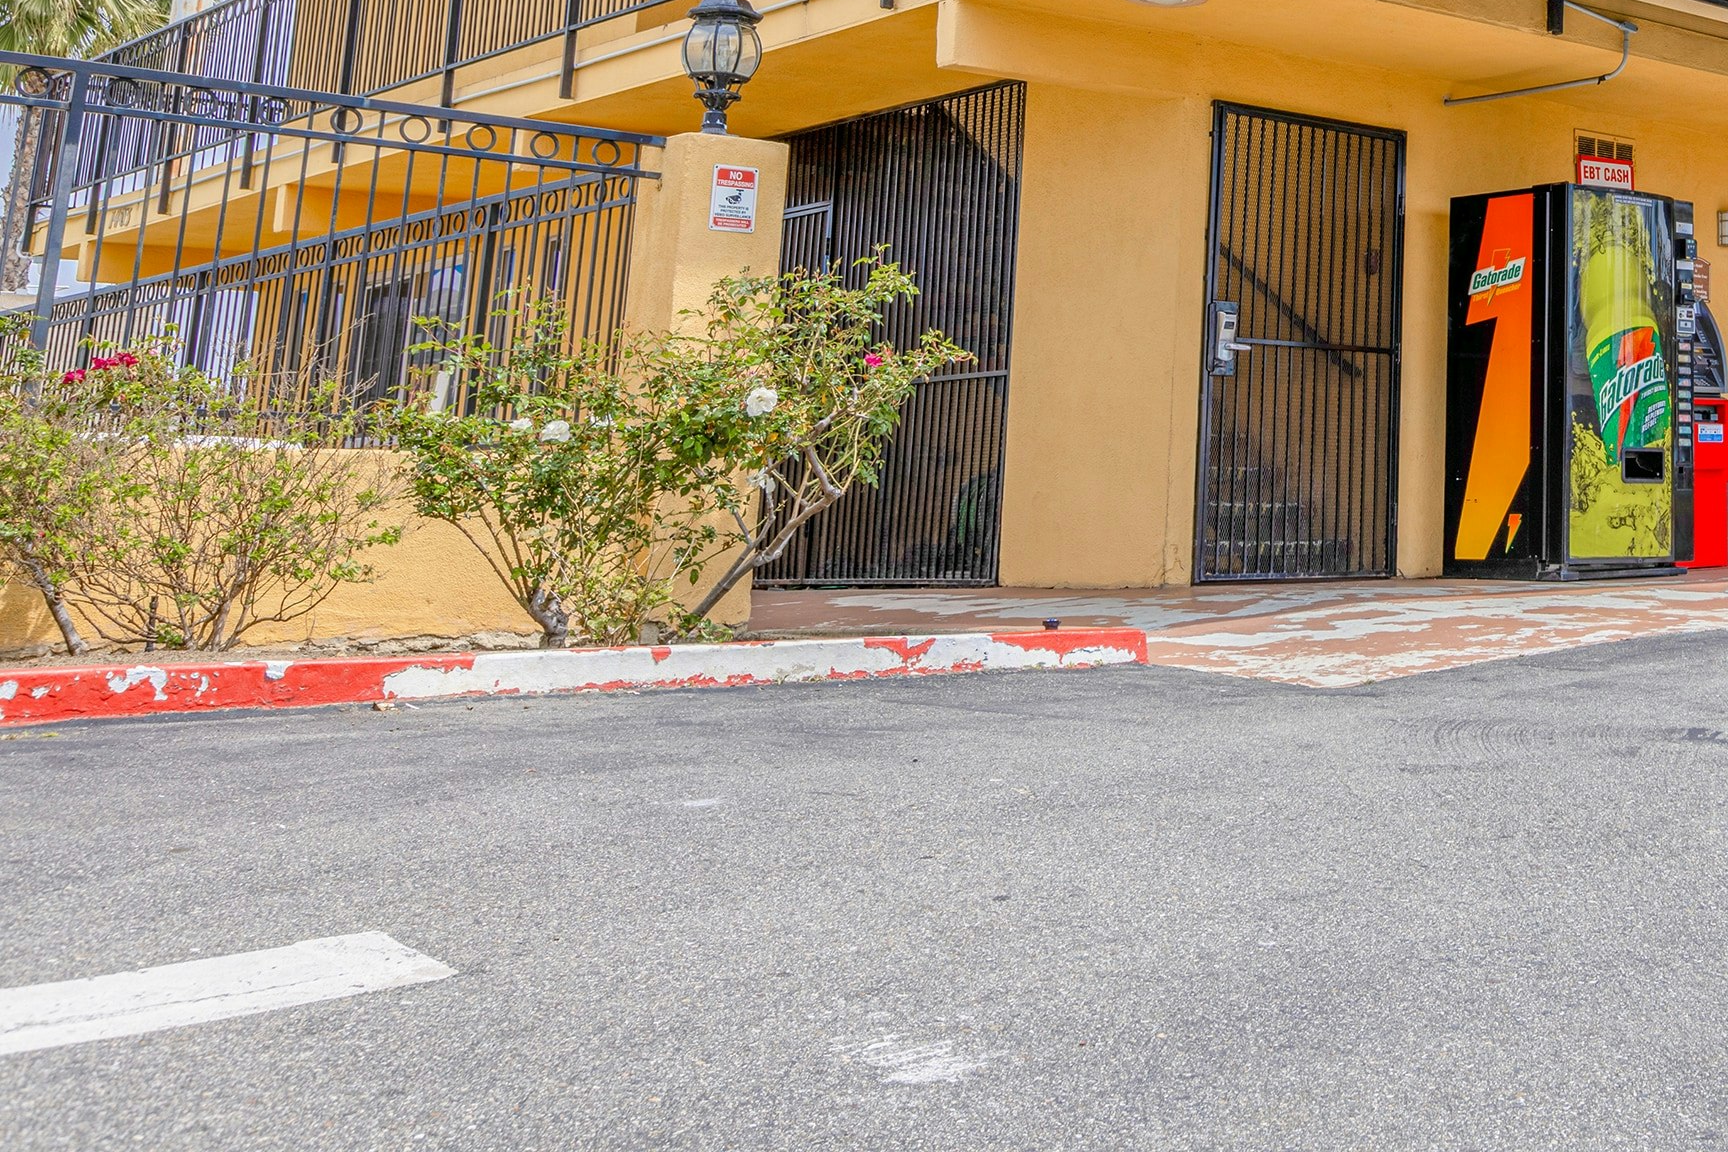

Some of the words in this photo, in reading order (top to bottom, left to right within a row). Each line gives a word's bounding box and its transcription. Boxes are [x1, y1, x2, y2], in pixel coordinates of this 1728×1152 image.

[730, 171, 743, 180] NO
[1583, 165, 1601, 180] EBT
[1604, 167, 1629, 183] CASH
[718, 179, 754, 188] TRESPASSING
[1472, 263, 1522, 290] Gatorade
[1600, 353, 1665, 427] Gatorade
